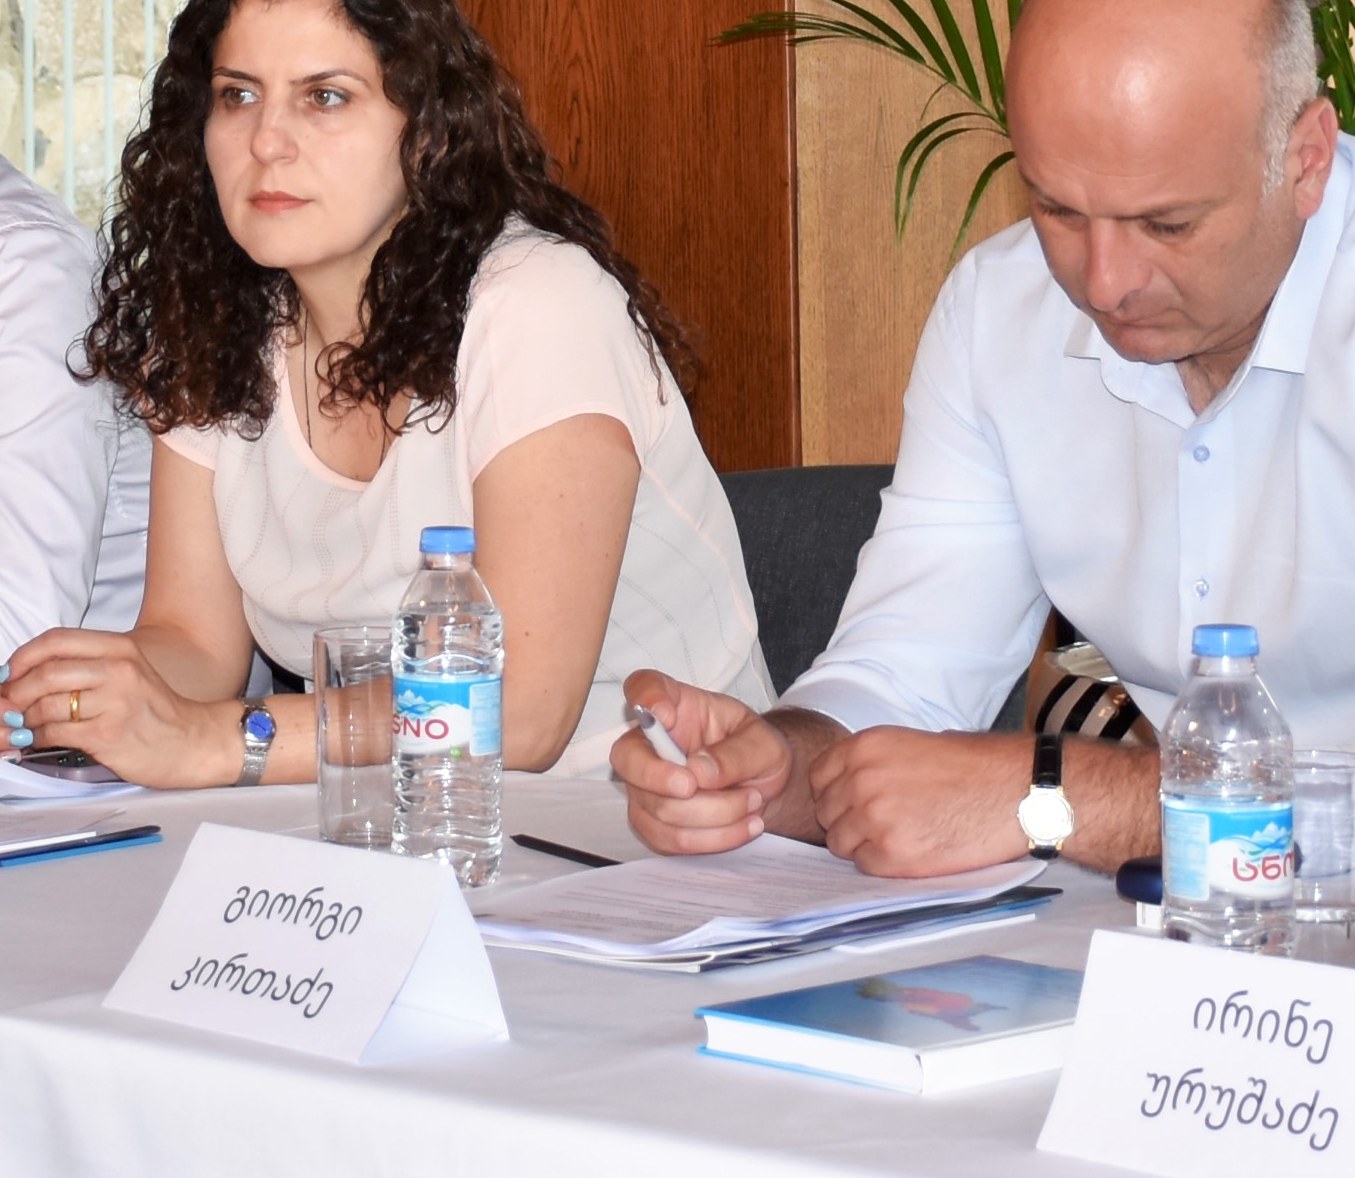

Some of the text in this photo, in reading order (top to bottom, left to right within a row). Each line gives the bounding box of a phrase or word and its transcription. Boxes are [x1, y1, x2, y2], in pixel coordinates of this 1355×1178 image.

[223, 885, 363, 941] გიორგი
[170, 953, 334, 1019] კირთაძე
[1193, 990, 1333, 1064] ირინე
[1140, 1067, 1339, 1151] ურუშაძე
